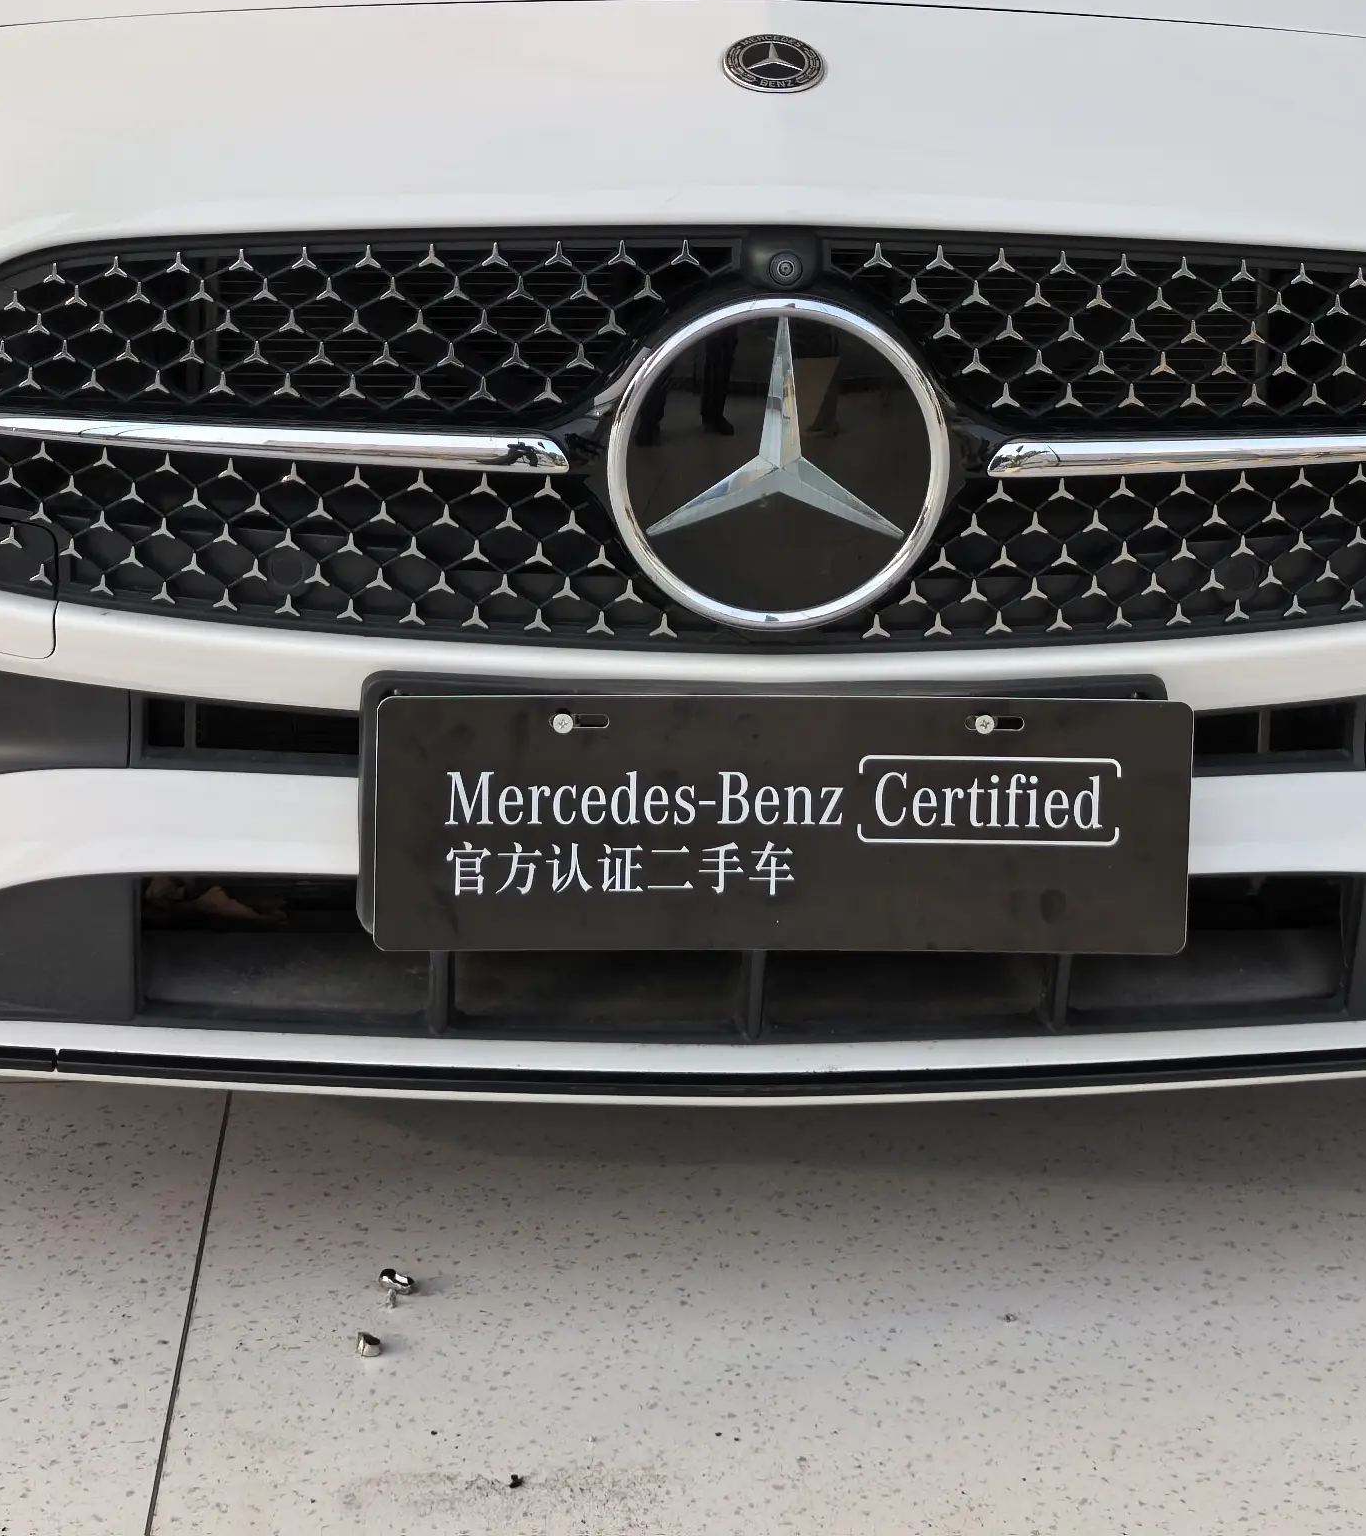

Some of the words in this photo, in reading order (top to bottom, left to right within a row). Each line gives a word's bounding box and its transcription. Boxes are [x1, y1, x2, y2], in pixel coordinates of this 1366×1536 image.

[740, 34, 805, 48] MERCEDES
[759, 78, 795, 88] BENZ
[444, 770, 844, 826] Mercedes-Benz
[874, 771, 1104, 830] Certified
[445, 840, 796, 896] 官方认证二手车
